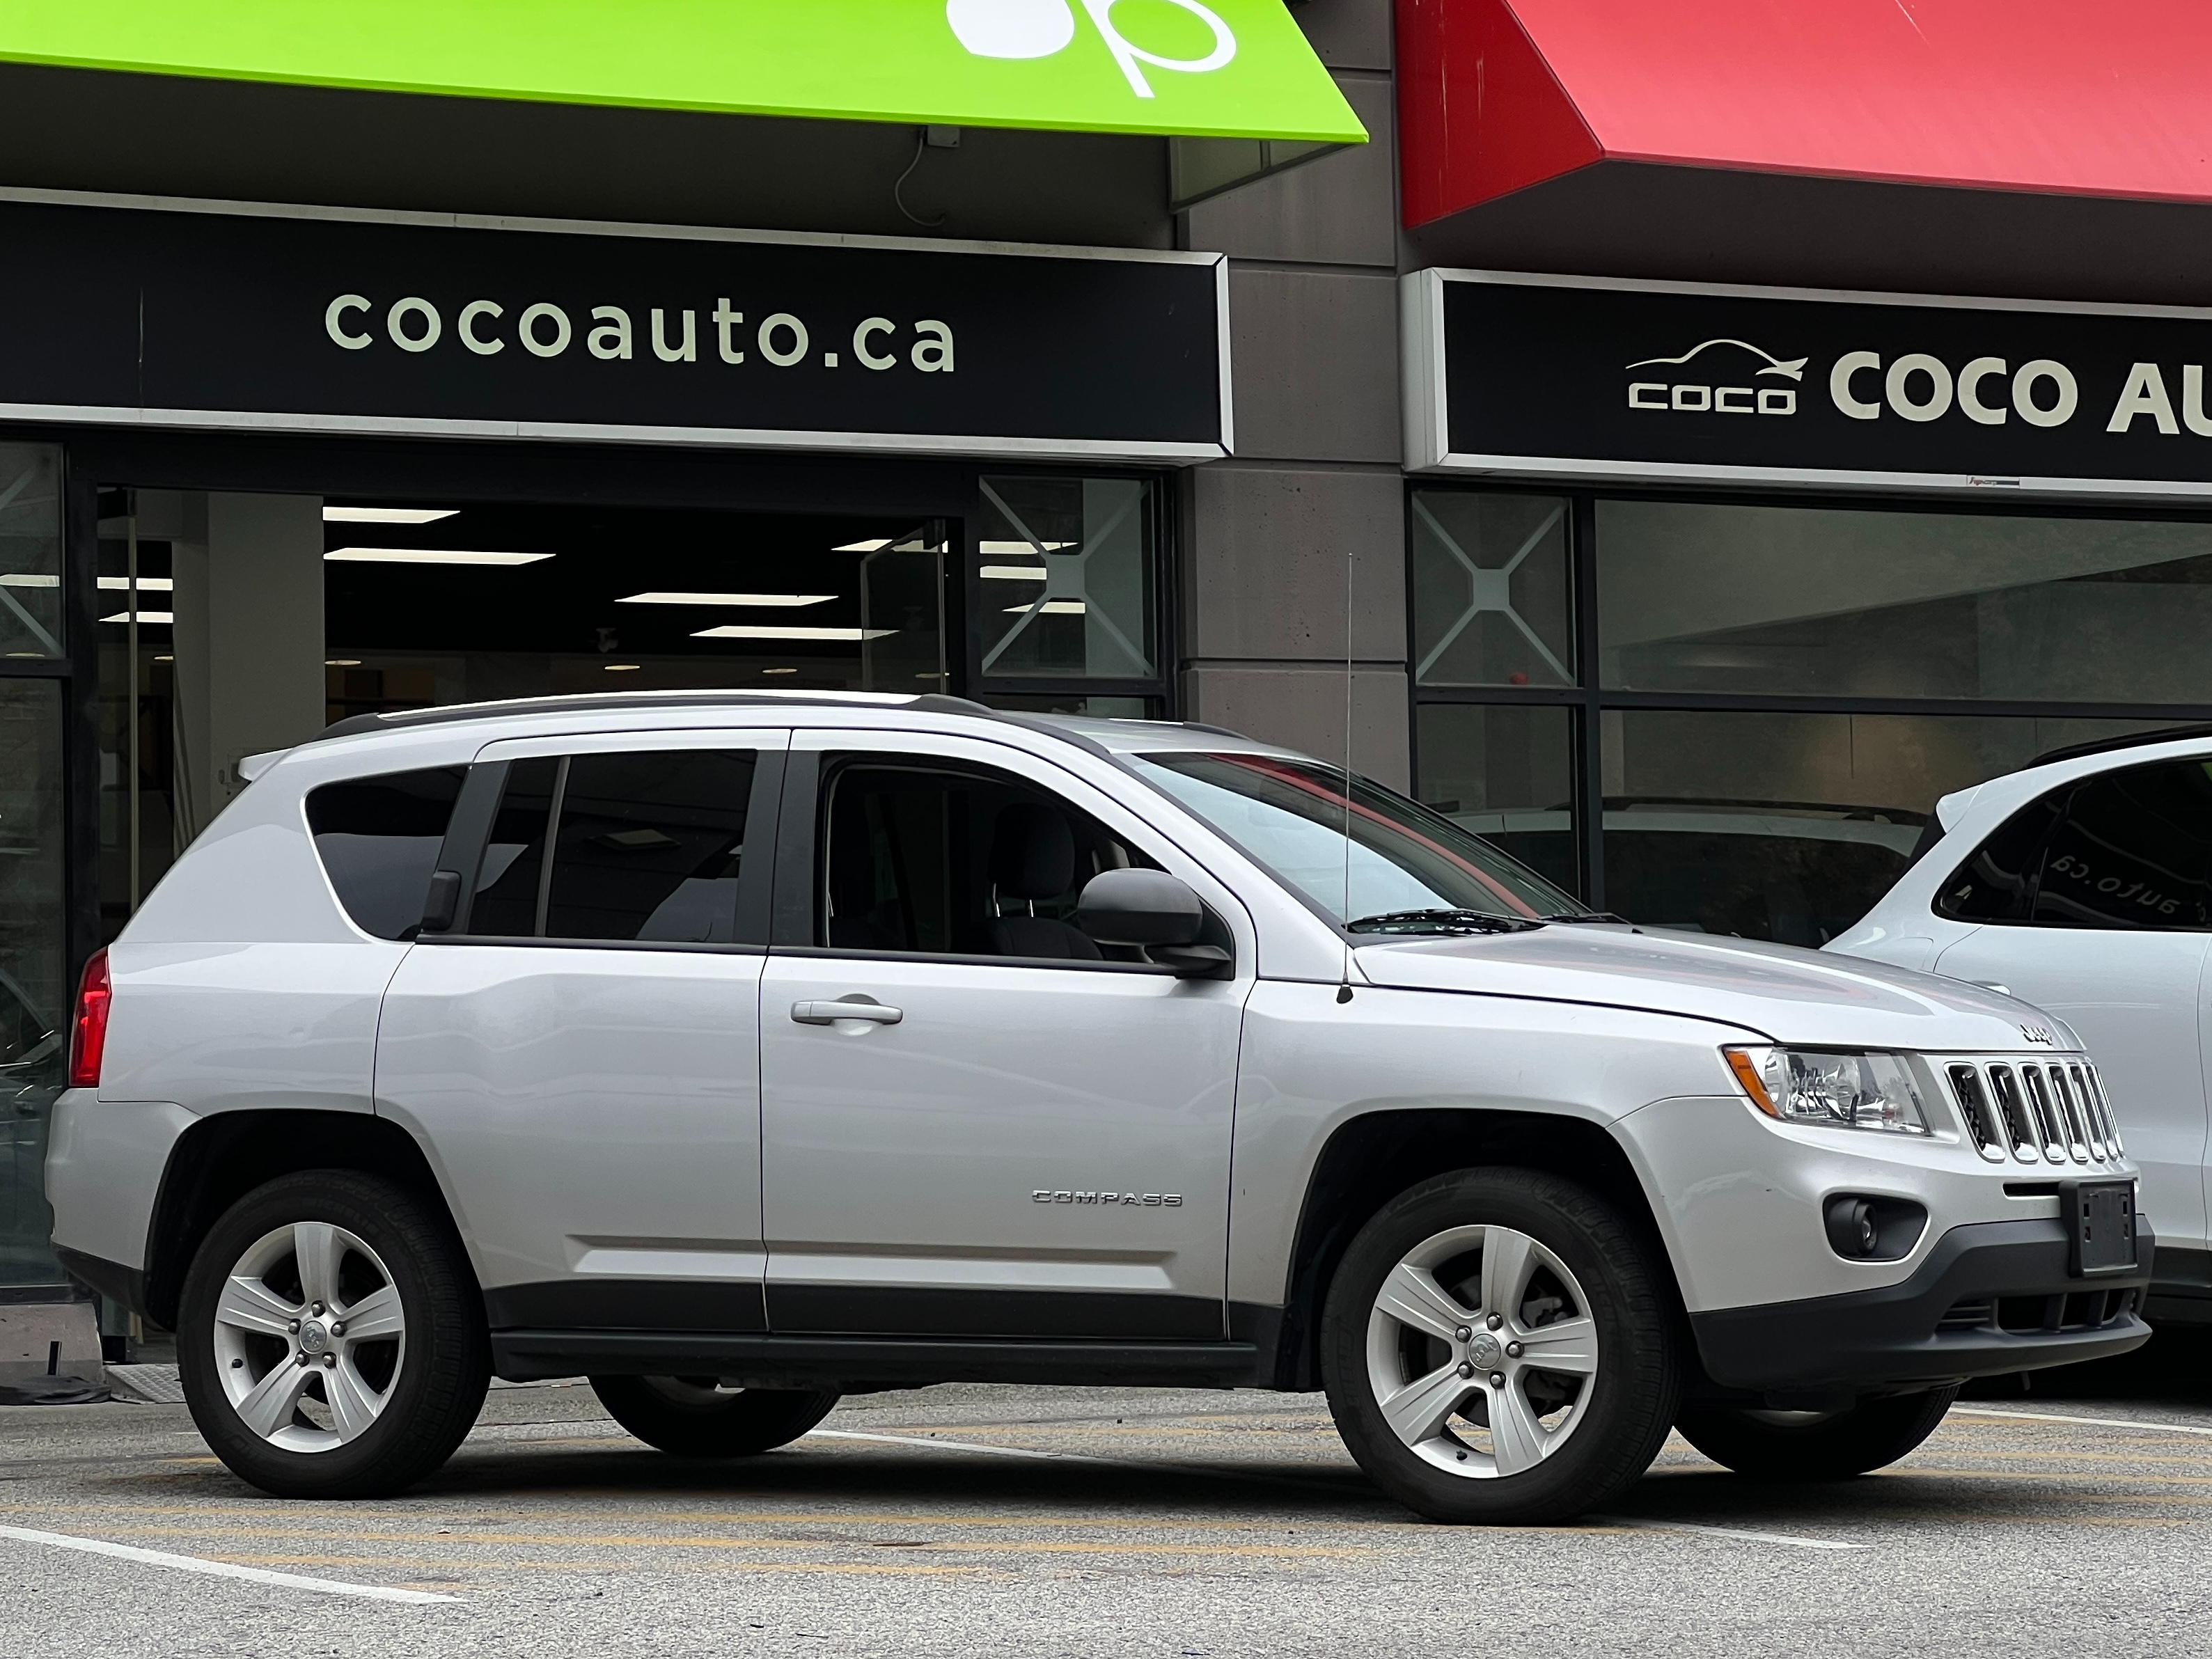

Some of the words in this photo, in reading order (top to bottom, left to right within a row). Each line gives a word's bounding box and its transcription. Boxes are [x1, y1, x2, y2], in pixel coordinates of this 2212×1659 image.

[325, 294, 955, 372] cocoauto.ca
[1629, 382, 1796, 415] COCO
[1830, 351, 2078, 427] COCO
[1032, 1190, 1182, 1207] COMPASS
